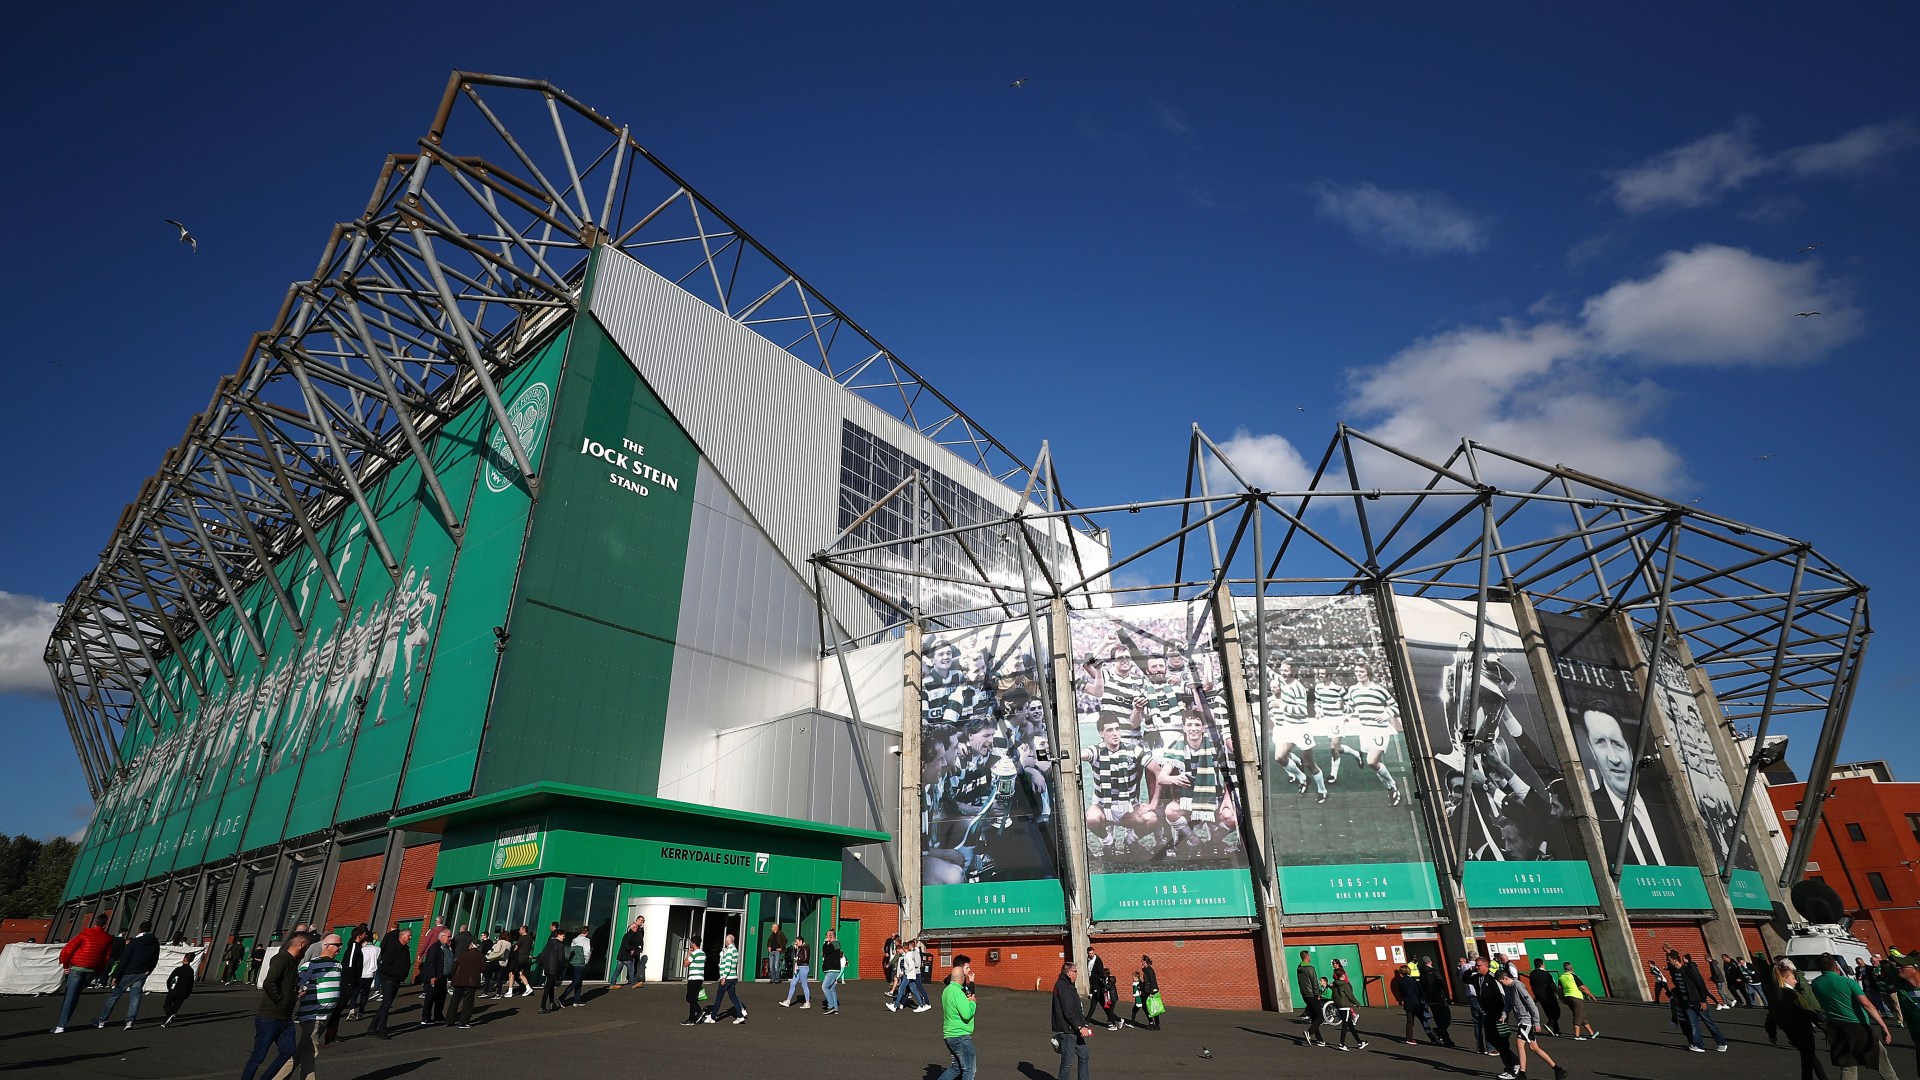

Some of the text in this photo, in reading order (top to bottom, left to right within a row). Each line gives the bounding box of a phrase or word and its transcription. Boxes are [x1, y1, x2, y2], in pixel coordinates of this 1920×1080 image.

[622, 438, 645, 456] THE
[580, 438, 678, 492] JOCK STEIN
[610, 473, 649, 497] STAND
[1553, 656, 1615, 689] ELTIC
[1304, 734, 1312, 745] 8
[123, 840, 169, 868] LEGENDS
[172, 829, 197, 852] ARE
[202, 814, 242, 842] MADE
[661, 847, 750, 866] KERRYDALE SUITE
[759, 858, 768, 872] 7
[1330, 877, 1388, 888] 1965-74
[1514, 874, 1542, 883] 1967
[1154, 884, 1187, 894] 1985
[977, 894, 1006, 904] 1988
[954, 908, 986, 916] CENTENARY
[1008, 906, 1031, 914] DOUBLE
